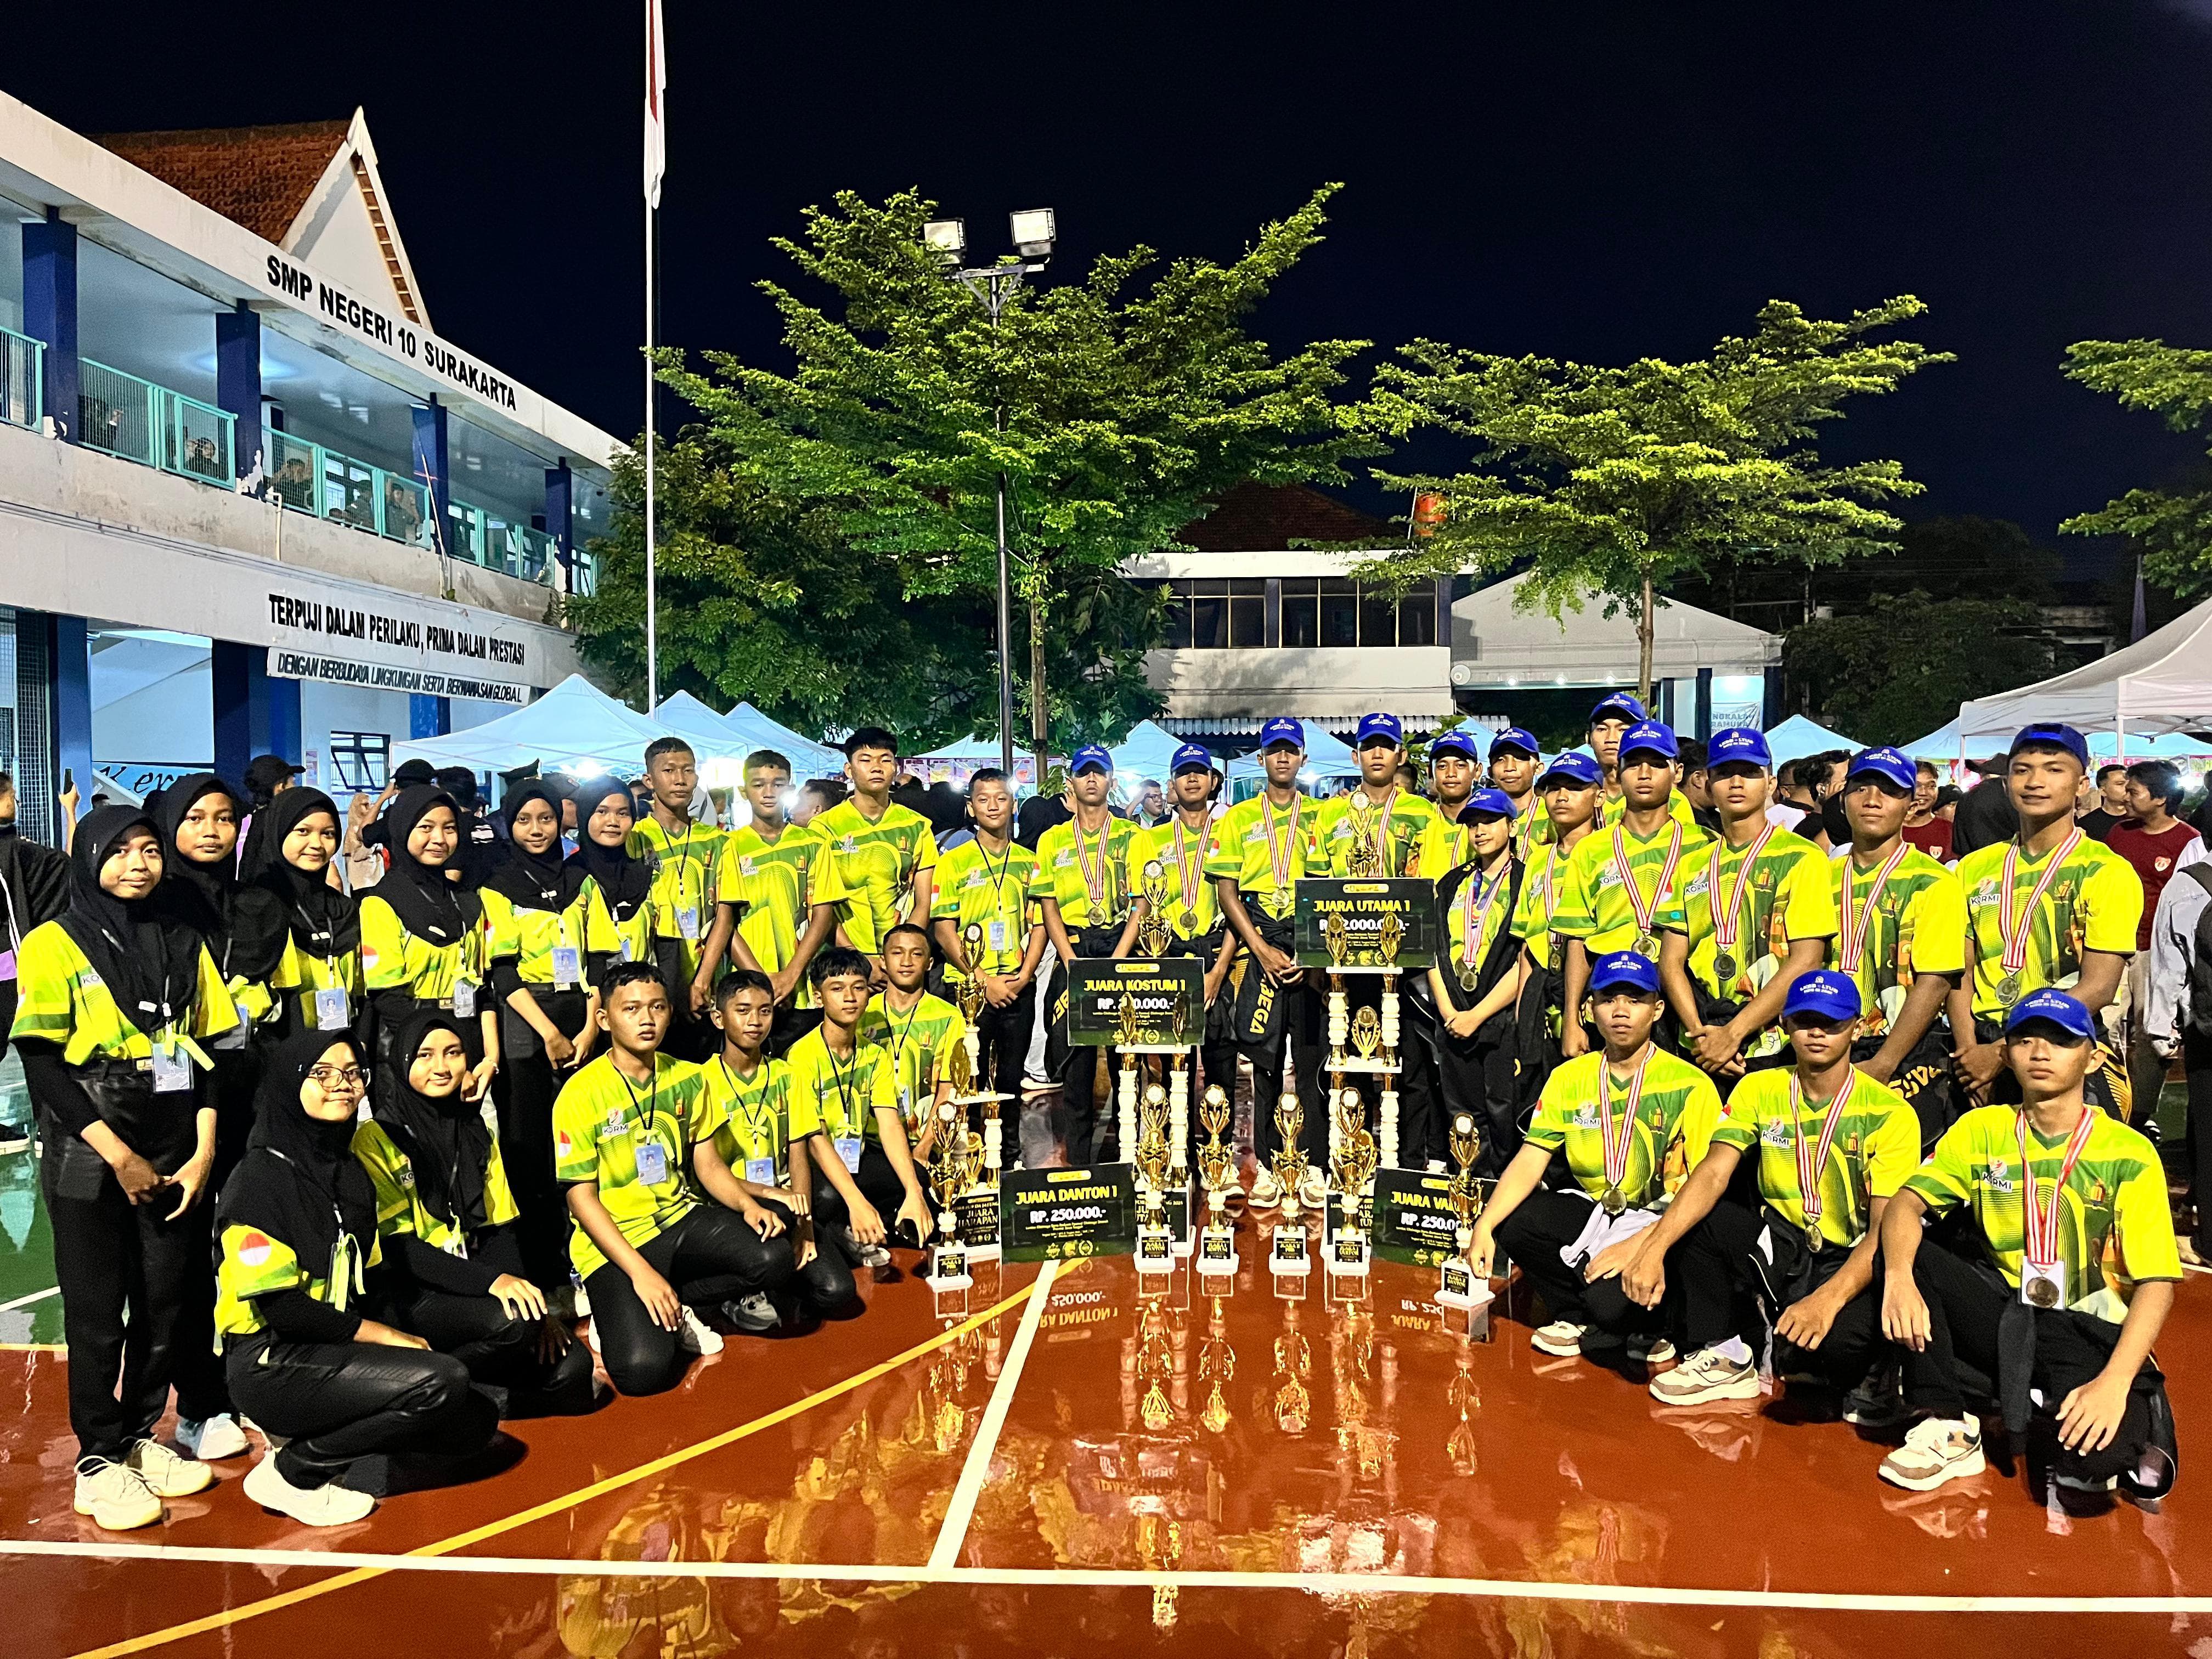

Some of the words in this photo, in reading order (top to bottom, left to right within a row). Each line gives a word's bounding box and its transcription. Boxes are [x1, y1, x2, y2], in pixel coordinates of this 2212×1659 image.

[267, 255, 313, 301] SMP
[320, 281, 393, 346] NEGERI
[398, 327, 416, 358] 10
[424, 340, 517, 411] SURAKARTA
[269, 594, 322, 631] TERPUJI
[326, 605, 365, 639] DALAM
[369, 614, 424, 654] PERILAKU,
[426, 625, 455, 653] PRIMA
[458, 631, 486, 659] DALAM
[489, 637, 525, 666] PRESTASI
[278, 653, 319, 677] DENGAN
[319, 659, 369, 684] BERBUDAYA
[371, 667, 421, 690] LINGKUNGAN
[422, 674, 445, 693] SERTA
[493, 684, 522, 703] GLOBAL
[1247, 833, 1267, 841] KORM
[1685, 882, 1708, 893] KORM
[1313, 900, 1355, 912] JUARA
[1356, 900, 1402, 912] UTAMA
[1404, 900, 1410, 912] 1
[1084, 979, 1124, 991] JUARA
[1125, 979, 1178, 991] KOSTUM
[1180, 979, 1186, 991] 1
[1015, 1189, 1057, 1205] JUARA
[1058, 1186, 1110, 1202] DANTON
[1111, 1185, 1118, 1198] 1
[1390, 1191, 1431, 1208] JUARA
[1030, 1210, 1049, 1223] RP.
[1401, 1212, 1420, 1227] RP.
